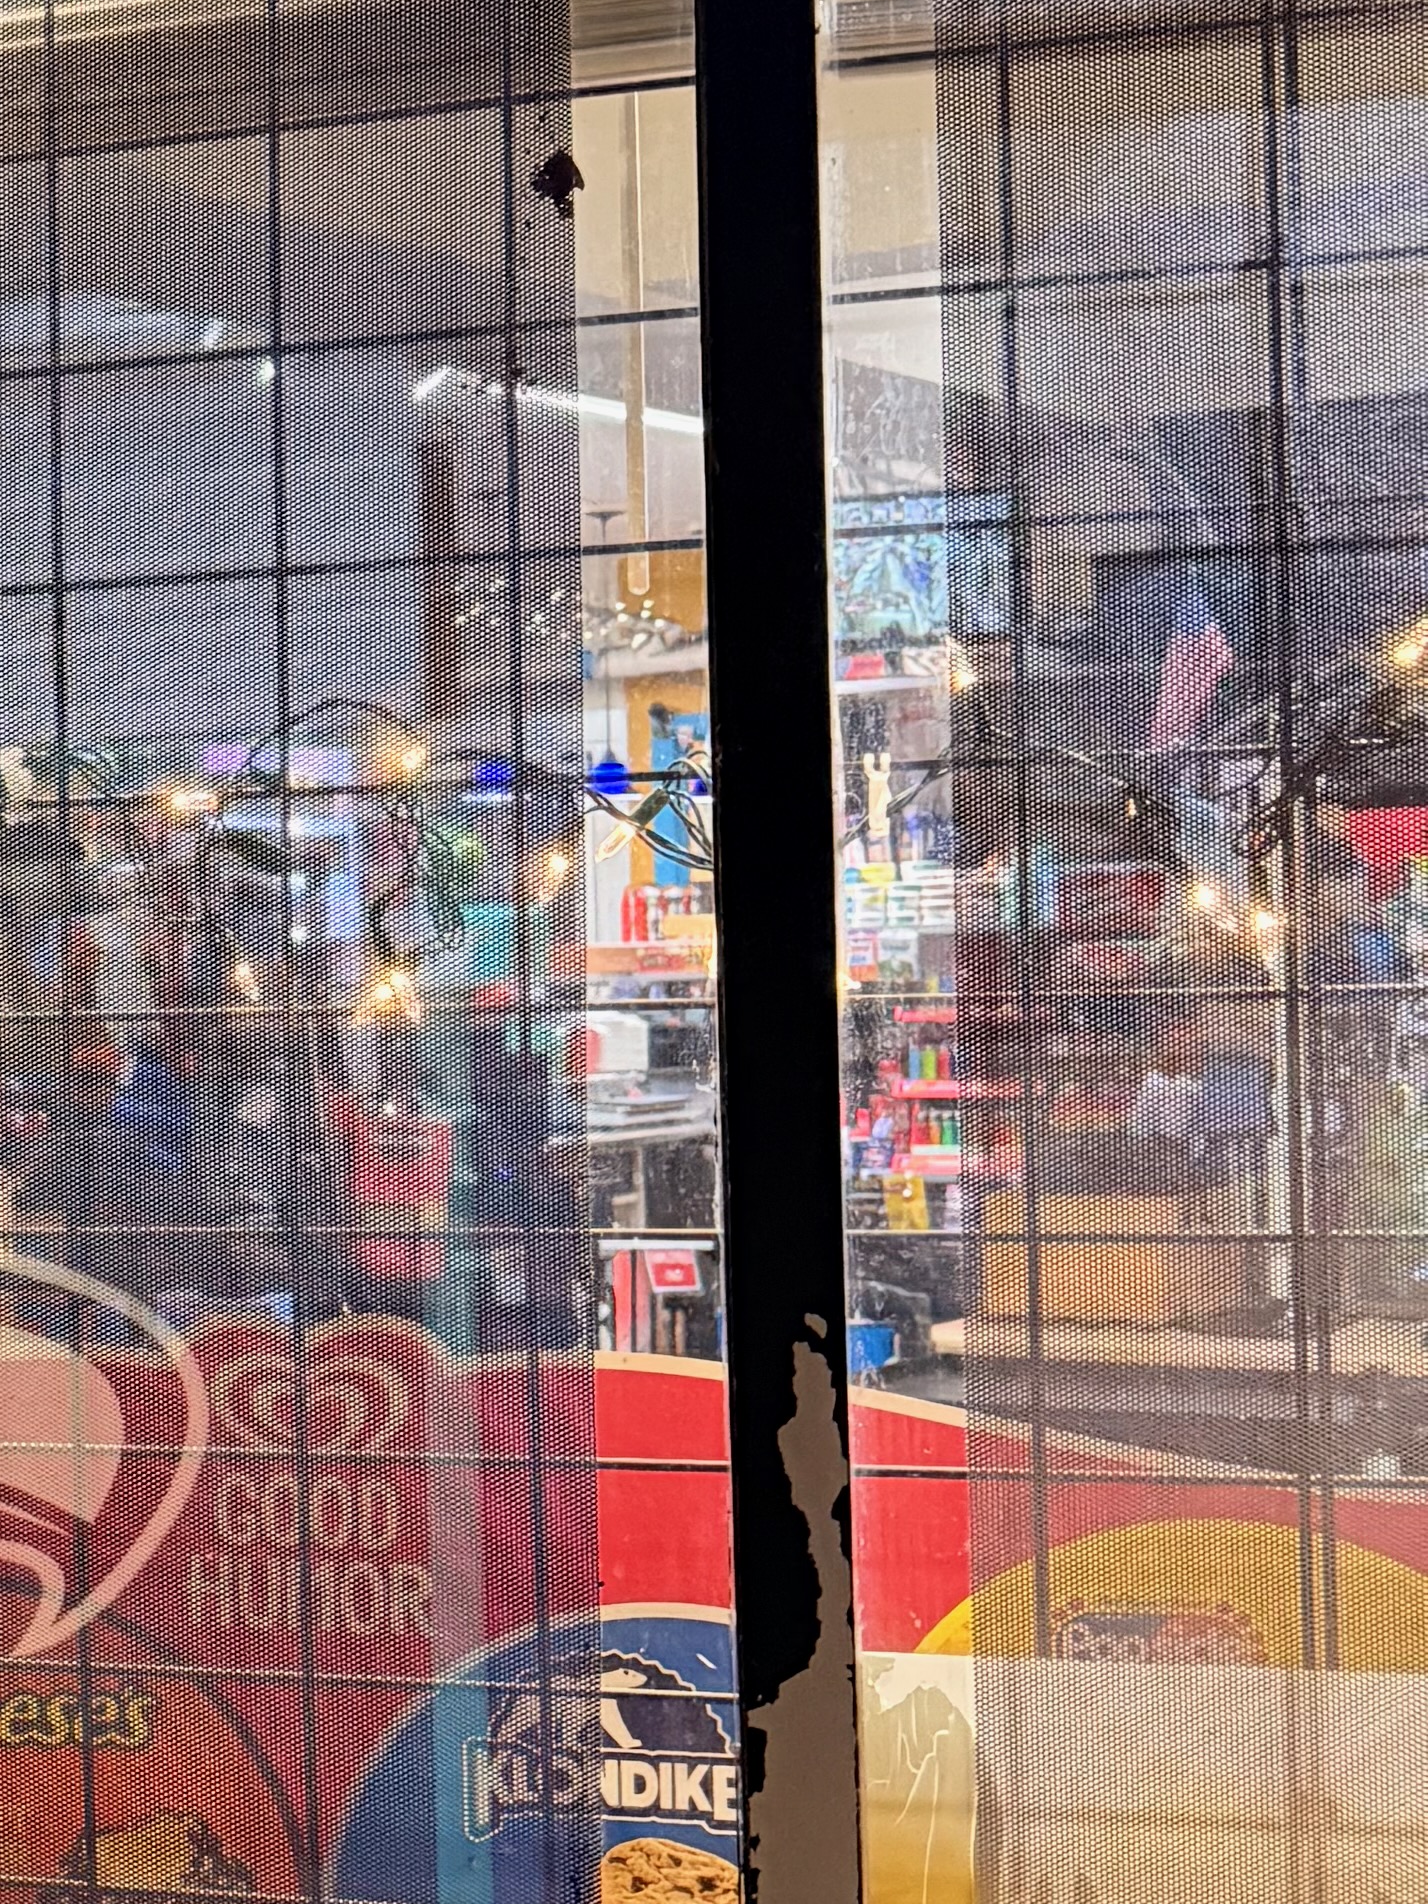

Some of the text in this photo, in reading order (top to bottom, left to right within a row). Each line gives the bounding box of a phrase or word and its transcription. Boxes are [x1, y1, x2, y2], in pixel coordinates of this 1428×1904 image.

[217, 1476, 399, 1549] GOOD
[187, 1551, 436, 1639] HUMOR
[475, 1746, 740, 1829] KLONDIKE
